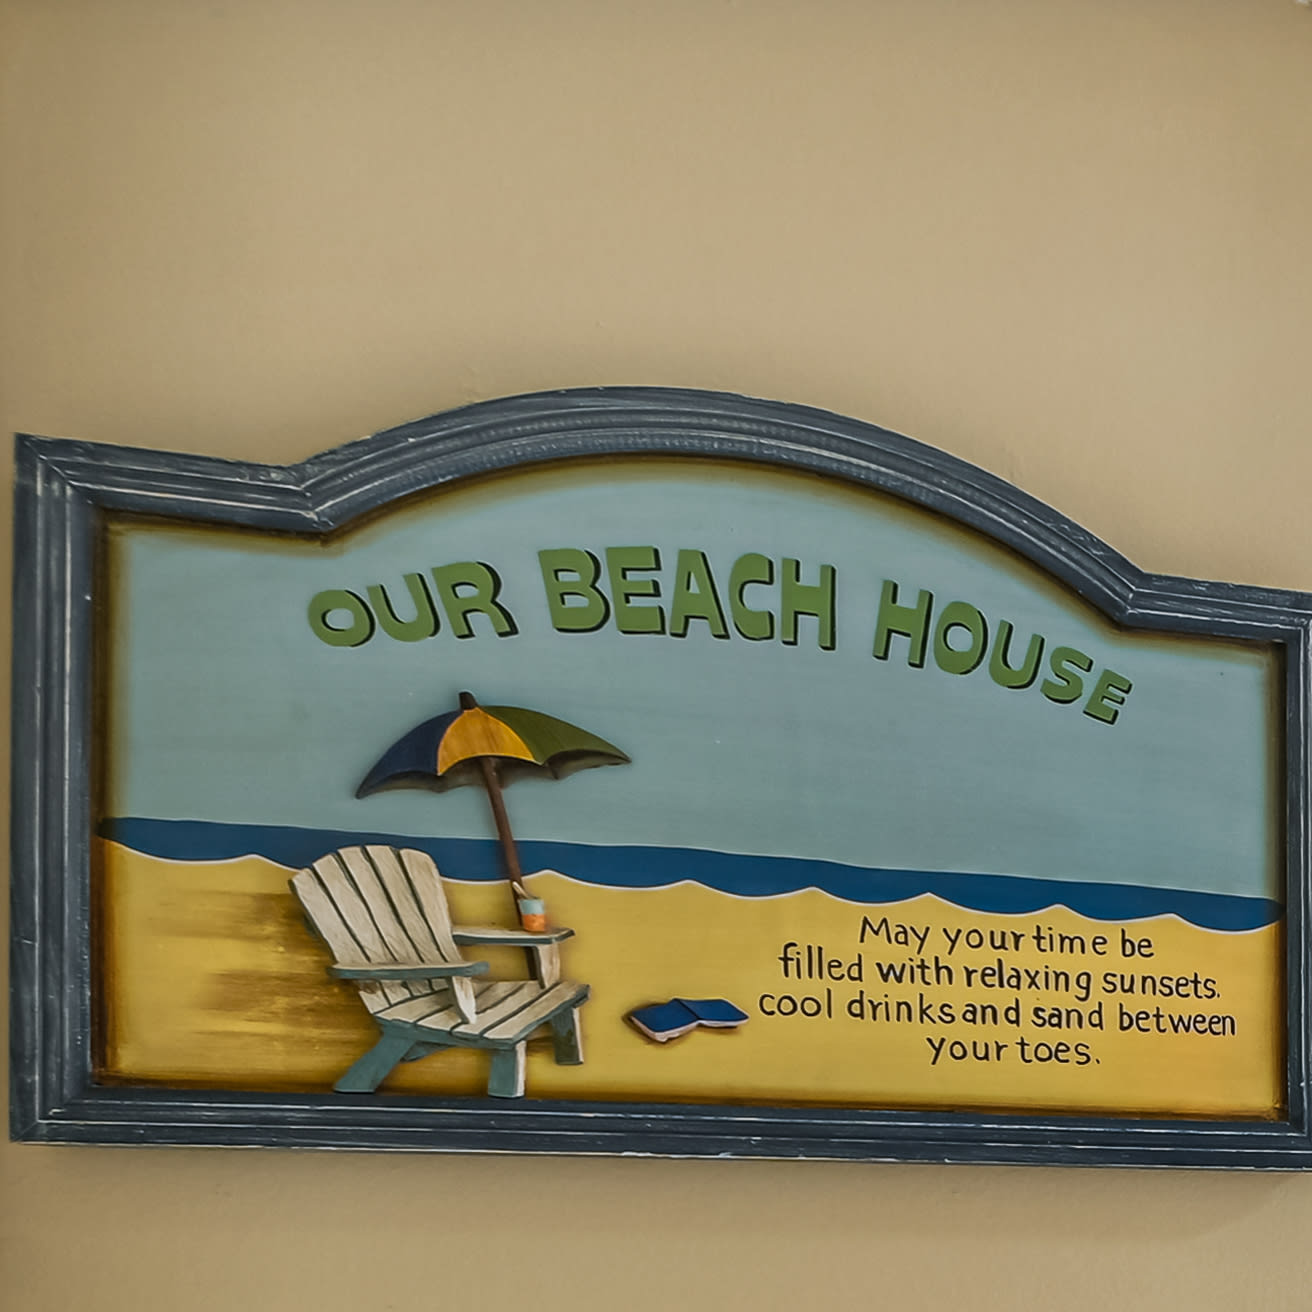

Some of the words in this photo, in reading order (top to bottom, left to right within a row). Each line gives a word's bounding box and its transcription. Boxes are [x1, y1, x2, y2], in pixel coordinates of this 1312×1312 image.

[308, 561, 519, 647] OUR
[538, 546, 836, 651] BEACH
[872, 580, 1132, 725] HOUSE
[859, 916, 930, 955] May
[943, 928, 1025, 955] your
[1032, 925, 1108, 955] time
[1121, 928, 1154, 958] be
[778, 942, 863, 982] filled
[876, 956, 953, 985] with
[963, 958, 1091, 1001] relaxing
[1102, 972, 1220, 999] sunsets.
[759, 988, 832, 1018] cool
[847, 990, 956, 1024] drinks
[962, 998, 1020, 1026] and
[1031, 1001, 1104, 1031] sand
[1119, 1003, 1236, 1036] between
[926, 1037, 1008, 1065] your
[1016, 1036, 1100, 1065] toes.
